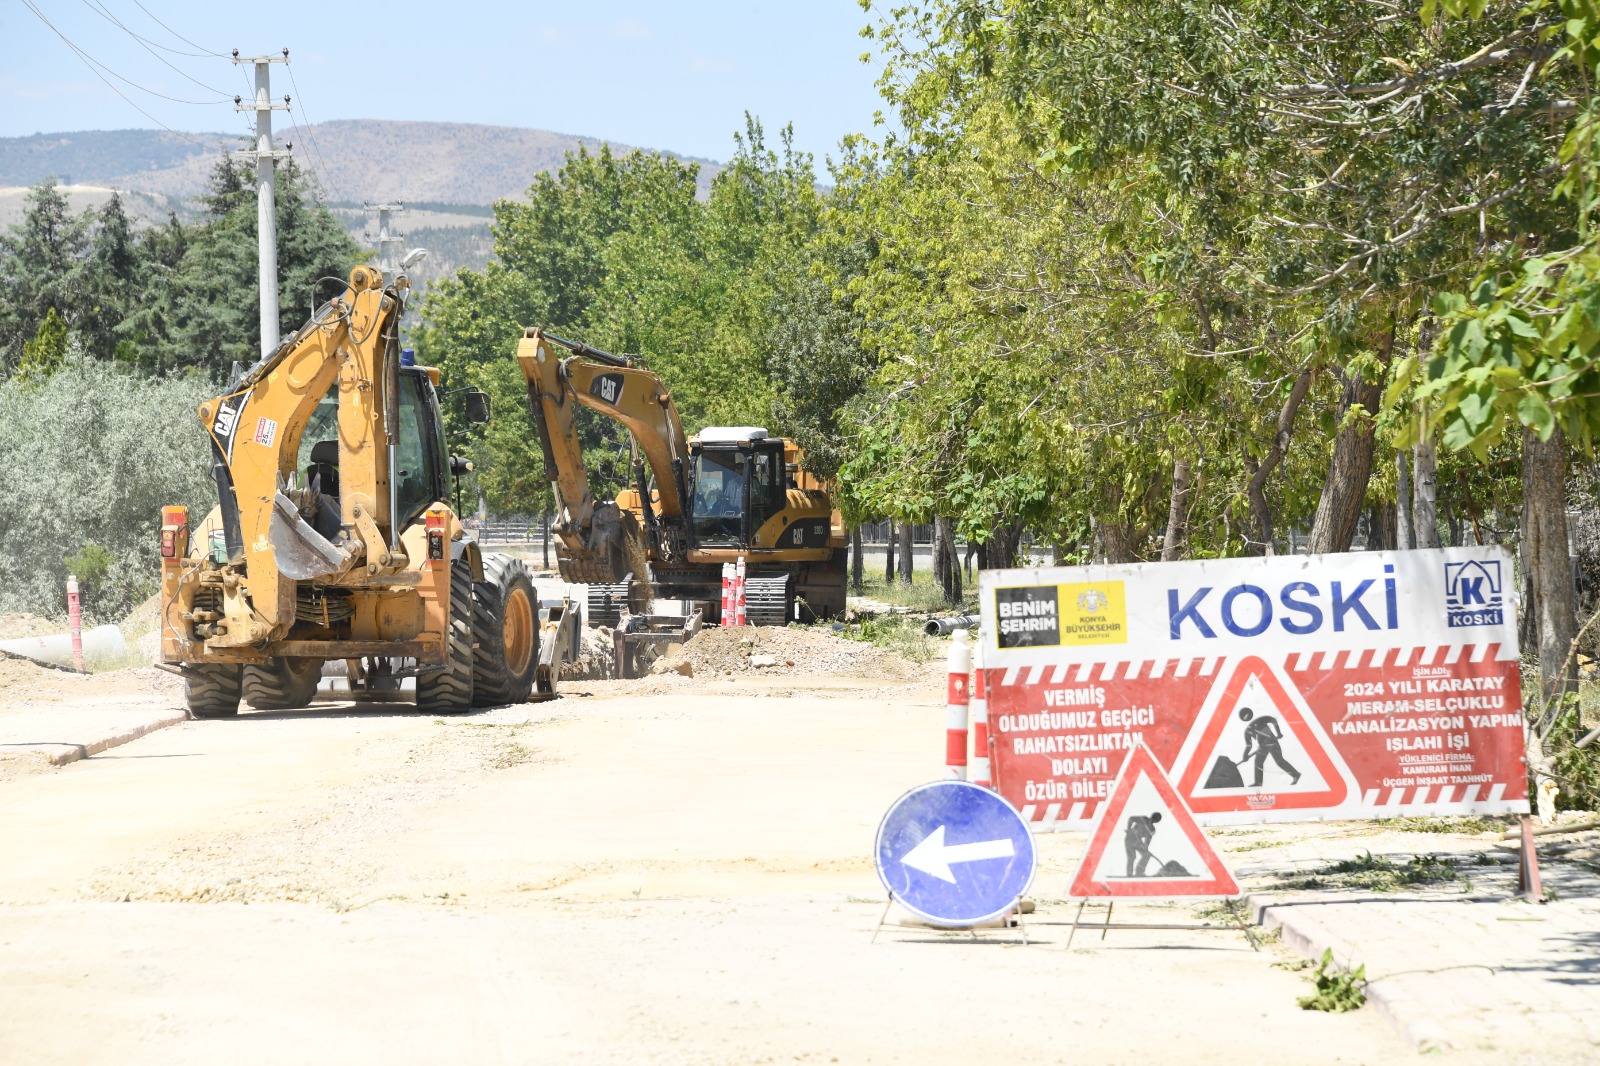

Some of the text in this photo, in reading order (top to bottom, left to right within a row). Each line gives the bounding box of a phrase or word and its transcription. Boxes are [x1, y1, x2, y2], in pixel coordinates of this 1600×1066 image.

[601, 376, 616, 402] CAT
[214, 402, 237, 437] CAT
[261, 434, 269, 445] 25
[792, 528, 803, 545] CAT
[1461, 577, 1486, 605] K
[999, 600, 1056, 617] BENİM
[1167, 564, 1399, 641] KOSKİ
[1000, 617, 1057, 635] ŞEHRİM
[1453, 610, 1499, 626] KOSKİ
[1043, 684, 1106, 708] VERMİŞ
[1343, 676, 1505, 697] 2024 YILI KARATAY
[1347, 695, 1504, 715] MERAM-SELÇUKLU
[999, 704, 1155, 732] OLDUĞUMUZ GEÇİCİ
[1331, 712, 1522, 735] KANALİZASYON YAPIM
[1447, 732, 1470, 751] İŞİ
[1052, 757, 1108, 776] DOLAYI
[1399, 752, 1444, 763] YÜKLENİCİ
[1403, 763, 1472, 775] KAMURAN İNAN
[1025, 779, 1068, 801] ÖZÜR
[1383, 774, 1493, 788] ÜÇGEN İNŞAAT TAAHHÜT
